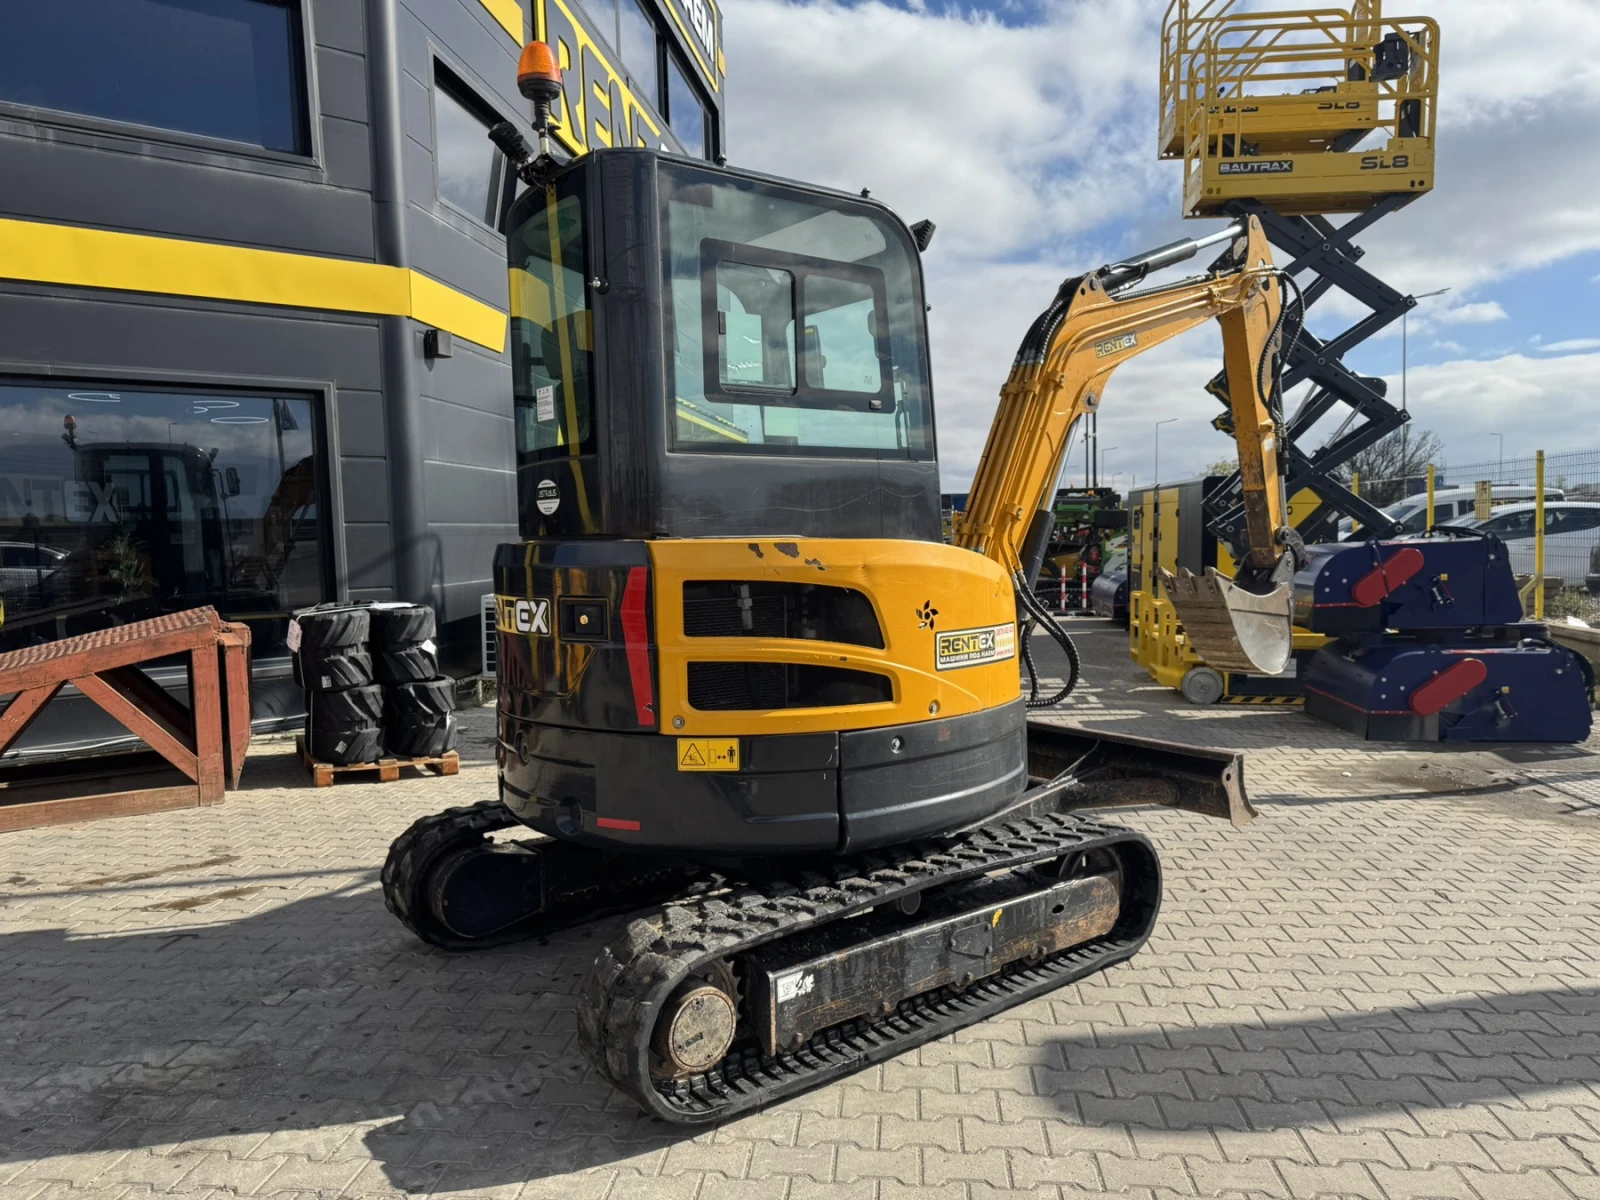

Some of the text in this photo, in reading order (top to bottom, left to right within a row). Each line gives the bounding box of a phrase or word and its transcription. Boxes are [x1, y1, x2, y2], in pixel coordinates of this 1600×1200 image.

[1219, 160, 1293, 173] BAUTRAX
[1359, 155, 1410, 170] SL8
[1096, 332, 1137, 356] RENTEX
[495, 597, 549, 634] NTEX
[941, 632, 995, 654] RENTEX
